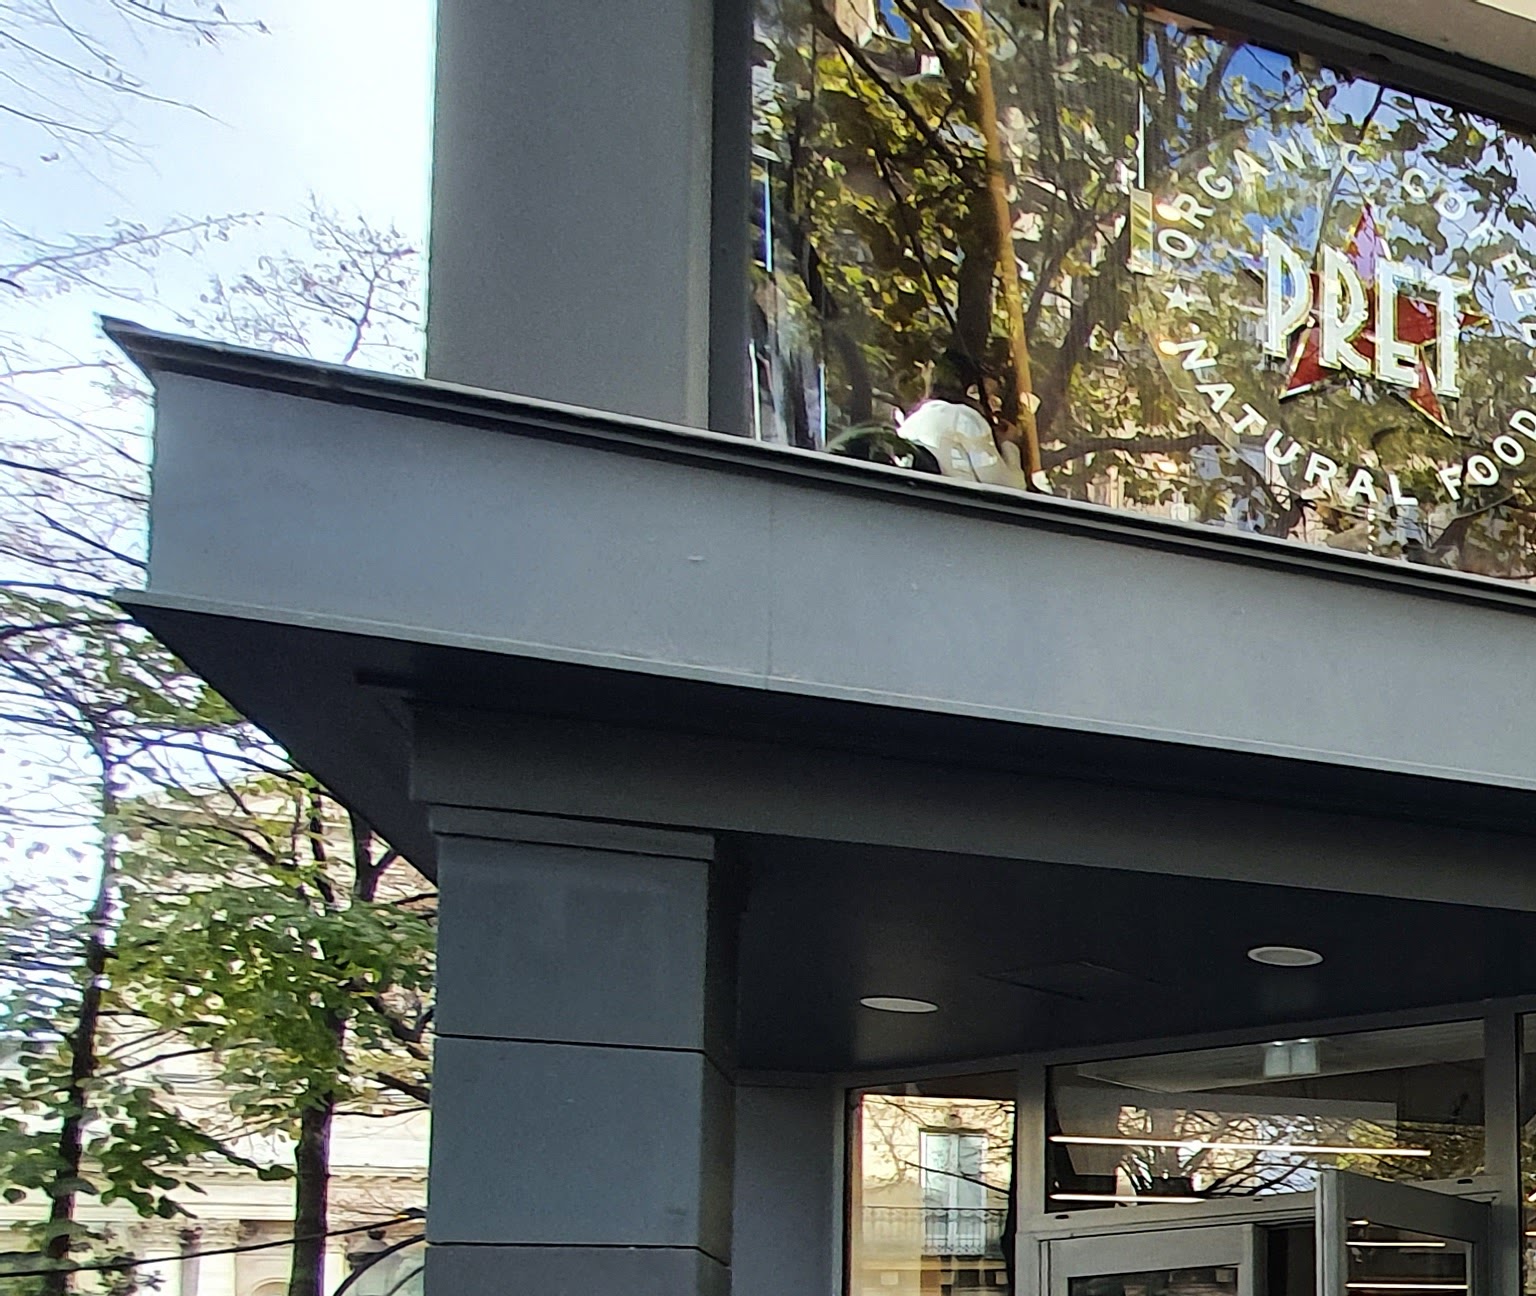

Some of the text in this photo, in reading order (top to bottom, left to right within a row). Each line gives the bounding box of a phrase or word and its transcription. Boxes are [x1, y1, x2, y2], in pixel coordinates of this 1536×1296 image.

[1157, 137, 1368, 259] ORGANIC
[1263, 227, 1474, 397] PRET
[1177, 323, 1418, 506] NATURAL
